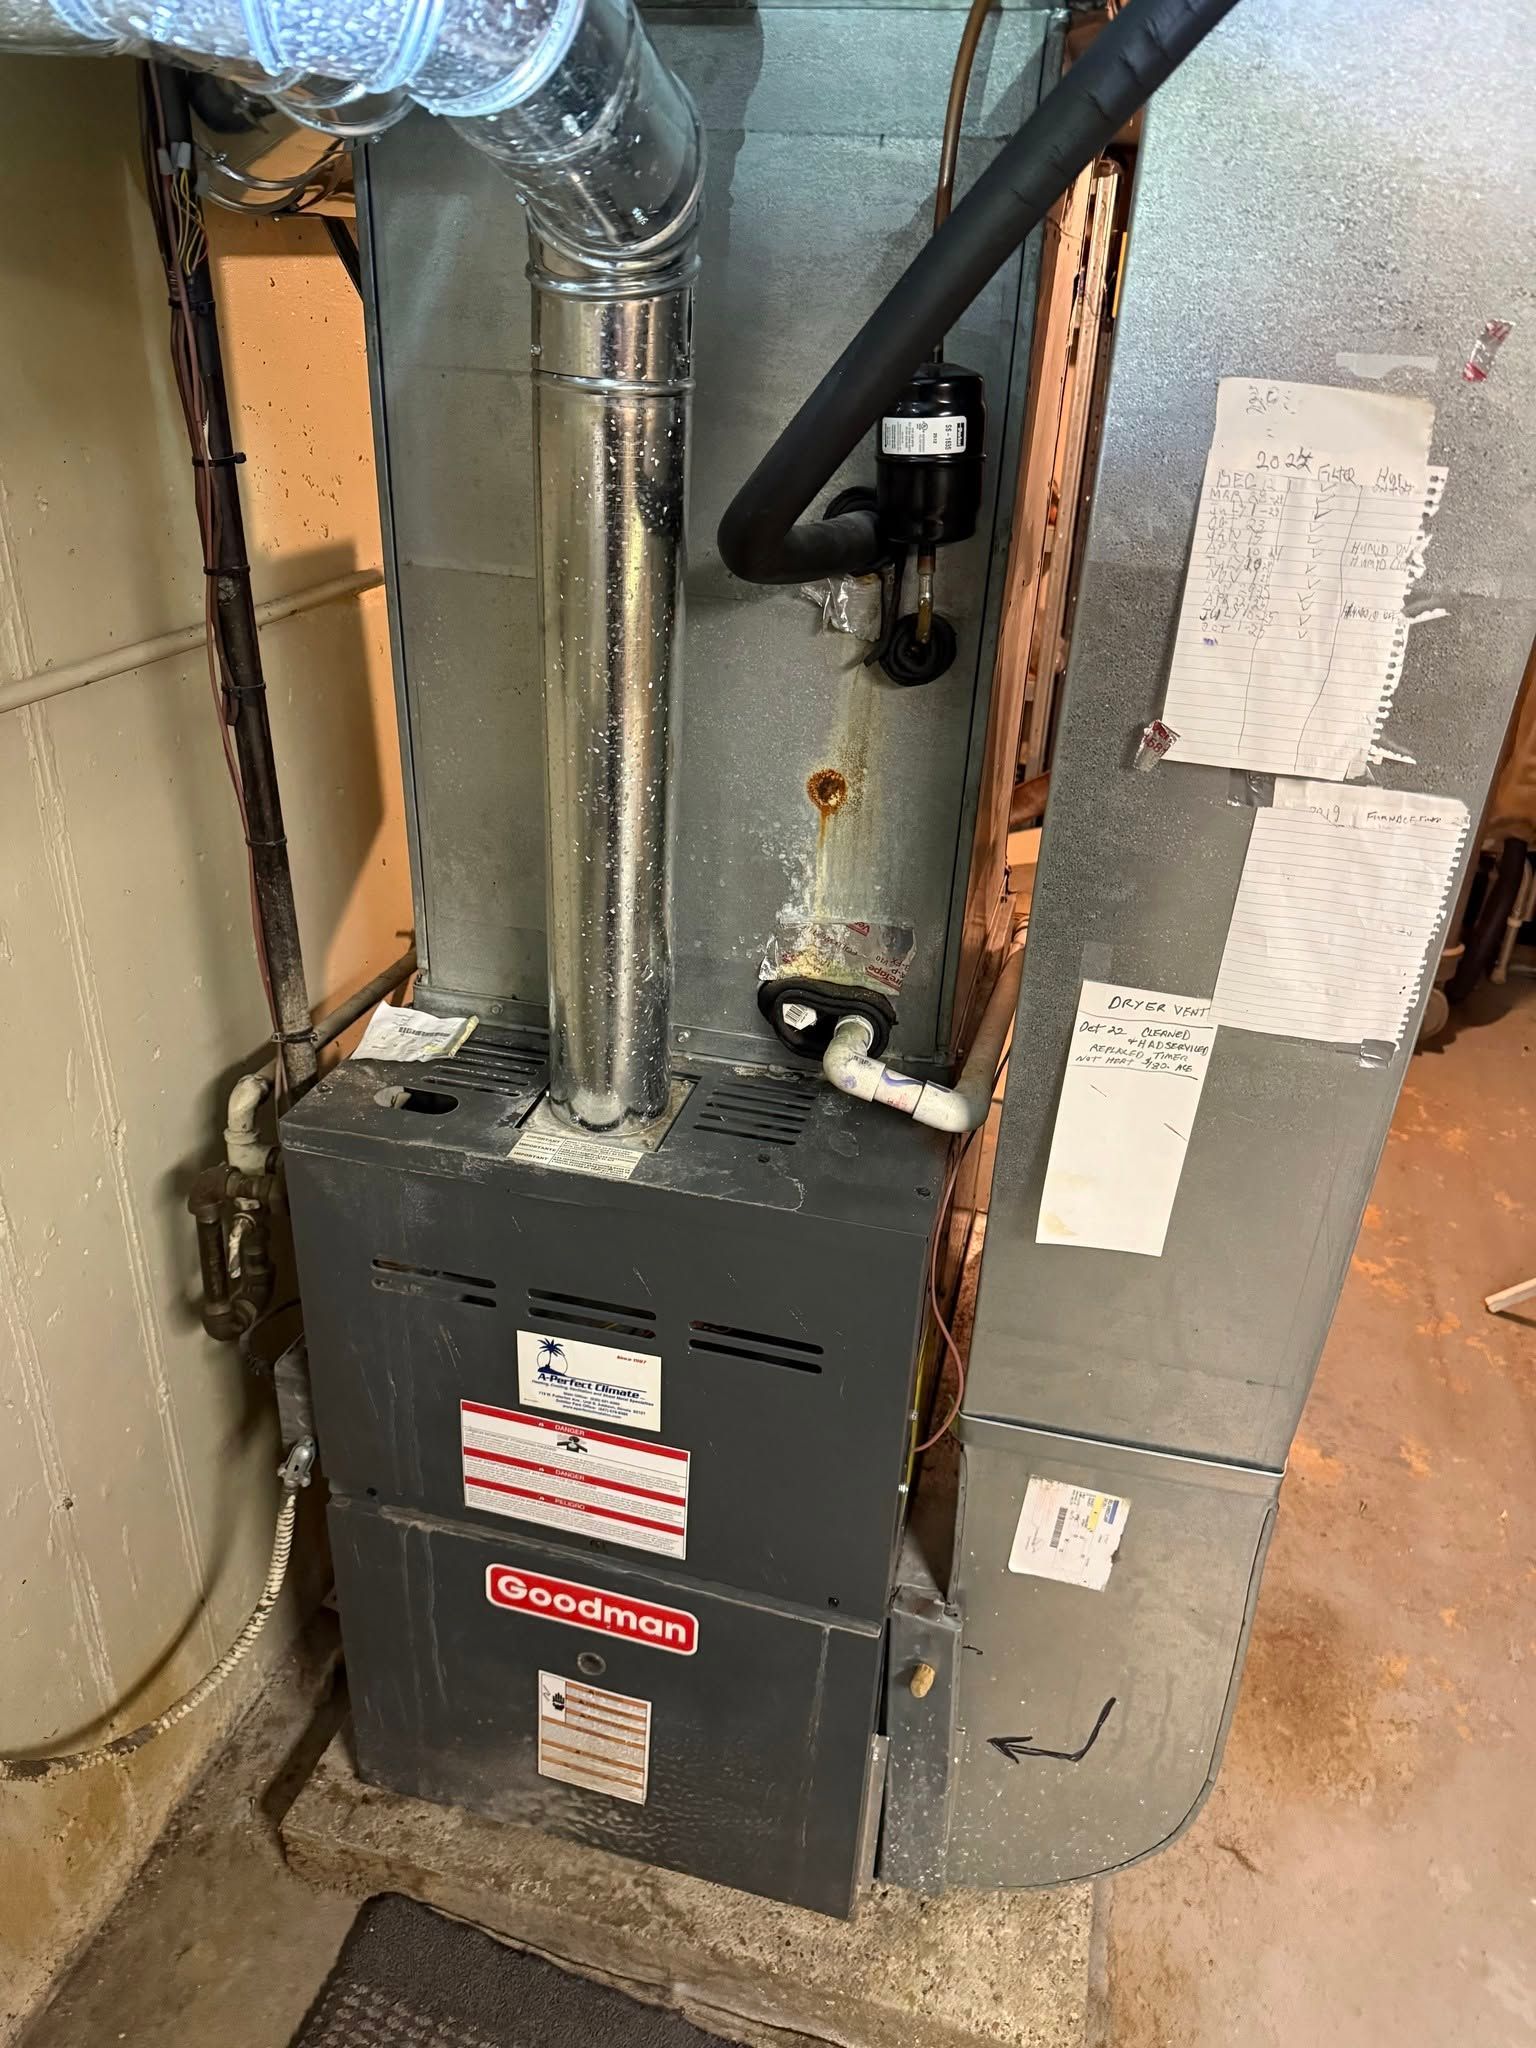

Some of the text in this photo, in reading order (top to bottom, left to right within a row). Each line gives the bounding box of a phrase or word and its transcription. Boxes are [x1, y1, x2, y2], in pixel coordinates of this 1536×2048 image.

[1216, 469, 1256, 489] DEC
[1108, 995, 1211, 1017] DRYER VENT
[1079, 1021, 1191, 1040] Oct 22 CLEANED
[1075, 1055, 1101, 1063] NOT
[1089, 1043, 1188, 1062] REPLACED TIMER
[538, 1372, 639, 1399] A-Perfect Climate
[554, 1424, 585, 1437] DANGER
[555, 1469, 585, 1481] DANGER
[554, 1498, 586, 1510] PELIGRO
[497, 1575, 687, 1645] Goodman
